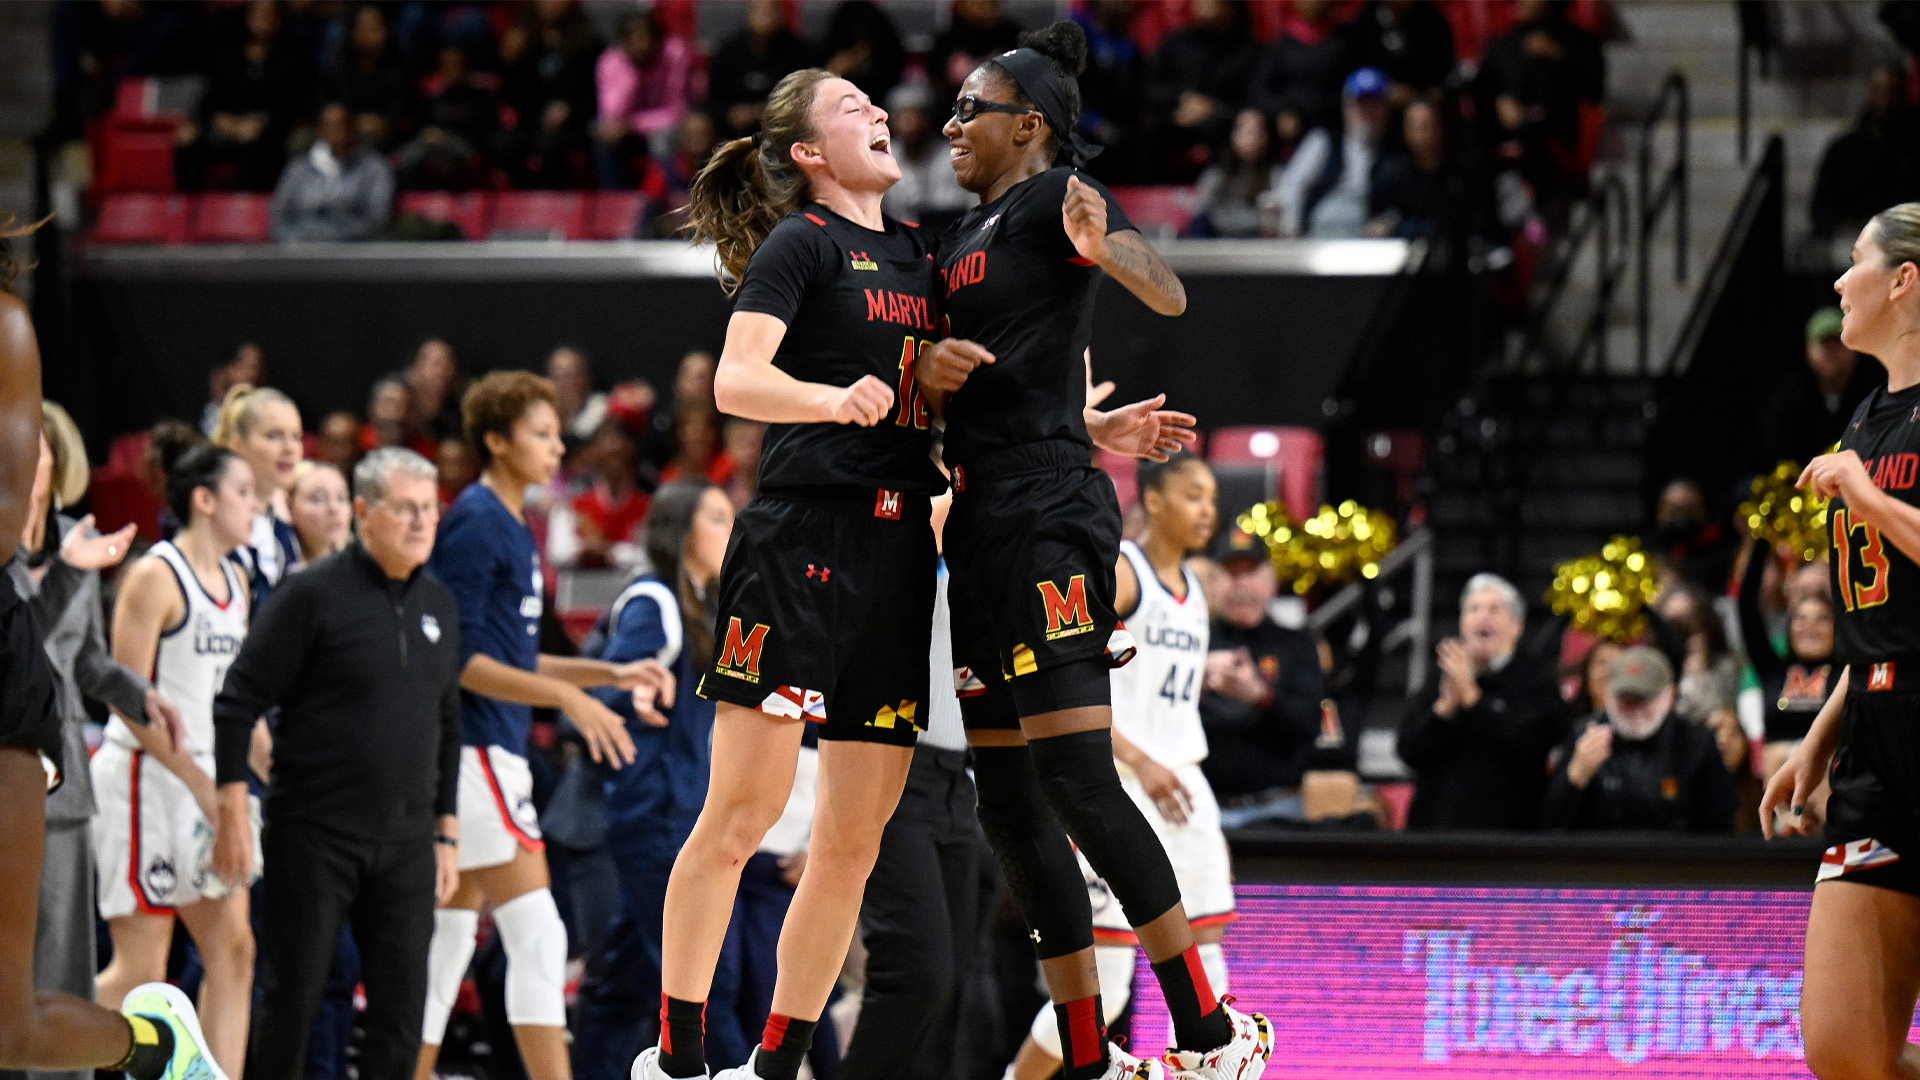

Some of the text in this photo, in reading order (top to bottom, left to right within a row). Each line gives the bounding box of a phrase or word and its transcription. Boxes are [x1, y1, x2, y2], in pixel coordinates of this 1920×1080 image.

[941, 250, 986, 299] LAND
[881, 490, 899, 513] M
[1833, 509, 1890, 612] 13
[1037, 574, 1093, 633] M
[718, 616, 770, 676] M
[1159, 664, 1195, 708] 44
